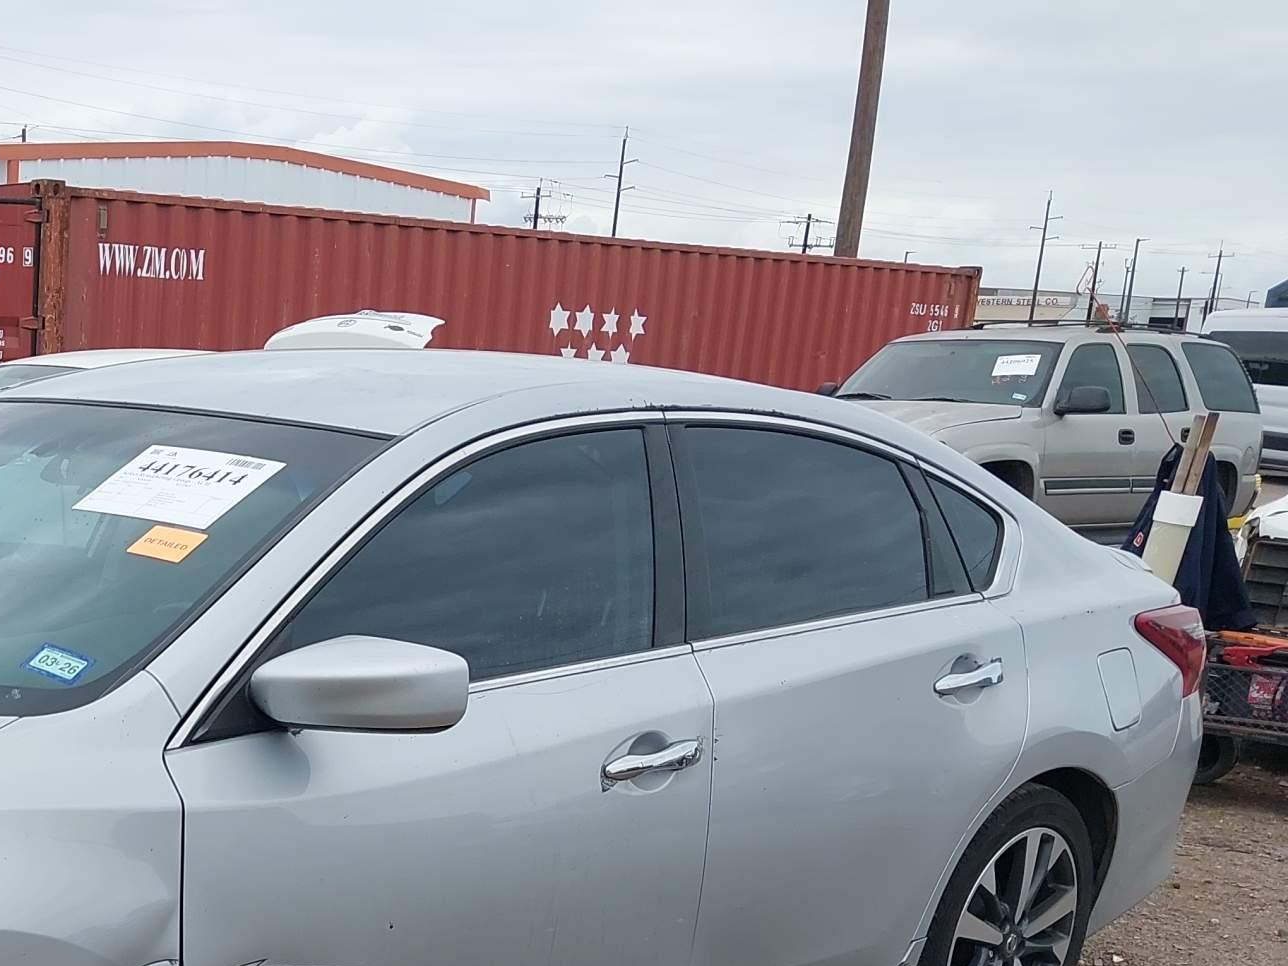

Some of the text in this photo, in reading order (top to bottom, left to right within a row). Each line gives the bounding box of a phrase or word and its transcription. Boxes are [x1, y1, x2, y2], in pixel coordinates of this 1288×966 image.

[24, 248, 33, 266] 9
[1016, 298, 1042, 306] STEL
[138, 460, 249, 486] 44176414
